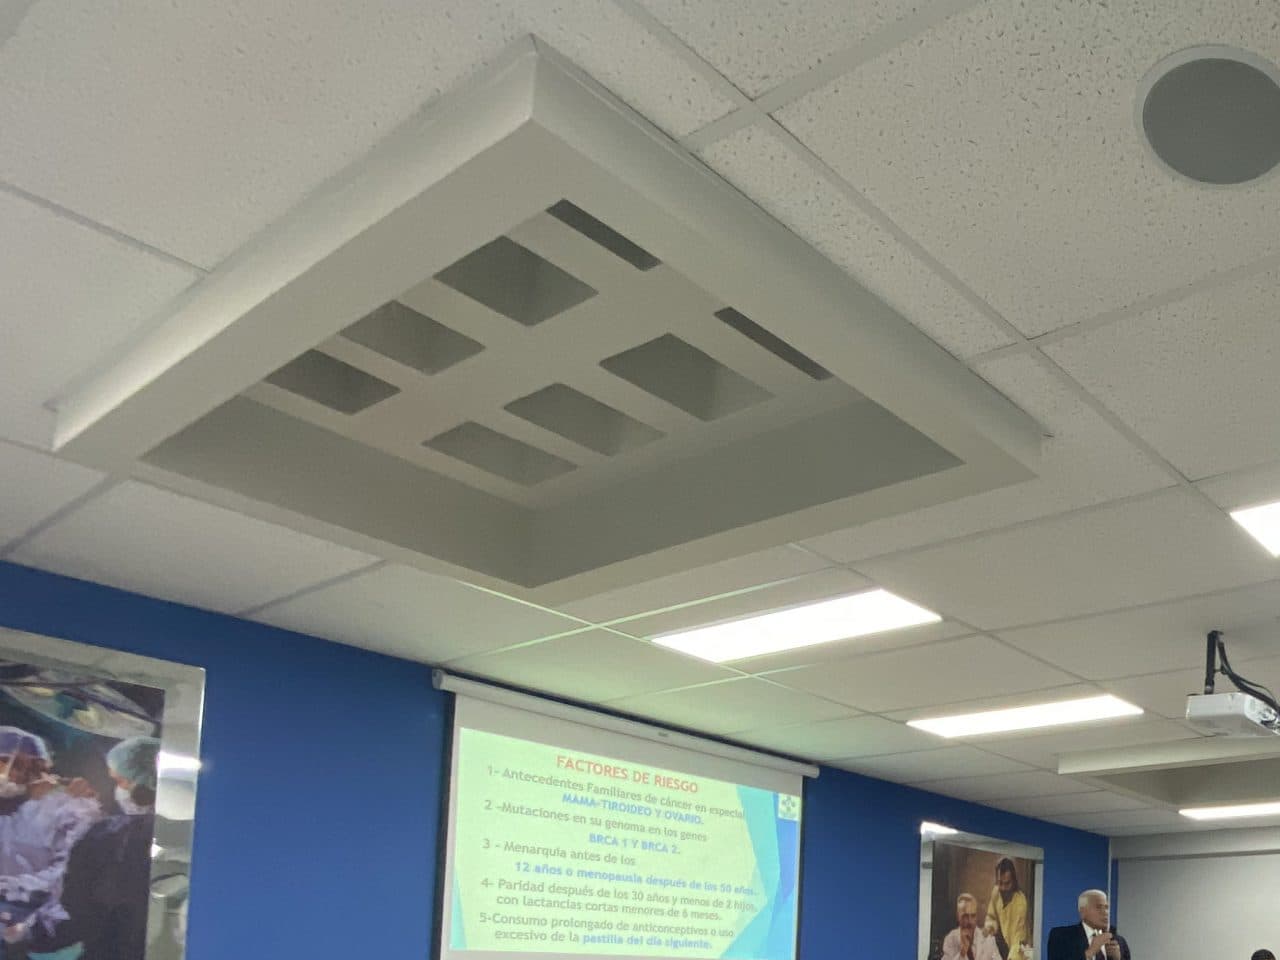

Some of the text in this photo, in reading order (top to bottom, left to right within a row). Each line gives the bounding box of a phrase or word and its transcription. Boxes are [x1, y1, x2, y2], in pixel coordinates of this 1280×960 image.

[557, 755, 698, 793] FACTORES DE RIESGO
[502, 768, 584, 791] Antecedentes
[587, 782, 642, 801] Familiares
[645, 794, 657, 803] de
[660, 796, 692, 810] cáncer
[695, 805, 707, 813] en
[710, 807, 745, 819] especial
[484, 799, 492, 810] 2
[573, 815, 586, 824] en
[590, 818, 602, 826] su
[605, 820, 646, 833] genoma
[648, 826, 660, 834] en
[664, 828, 678, 837] los
[680, 831, 707, 842] genes
[655, 809, 661, 817] Y
[482, 838, 490, 849] 3
[570, 850, 601, 861] antes
[604, 851, 617, 863] de
[621, 855, 636, 865] los
[589, 833, 619, 846] BRCA
[622, 838, 628, 847] 1
[630, 839, 639, 848] Y
[641, 841, 668, 853] BRCA
[515, 861, 530, 872] 12
[535, 864, 562, 876] años
[566, 868, 573, 876] o
[577, 870, 642, 885] menopausia
[646, 875, 686, 888] después
[689, 881, 701, 889] de
[704, 882, 717, 891] los
[720, 883, 731, 893] 50
[496, 895, 519, 905] con
[523, 895, 582, 910] lactancias
[585, 901, 618, 913] cortas
[622, 905, 665, 916] menores
[667, 908, 680, 917] de
[682, 908, 688, 918] 6
[498, 878, 544, 893] Paridad
[548, 882, 593, 897] después
[597, 887, 610, 898] de
[614, 889, 628, 899] los
[632, 890, 644, 900] 30
[646, 893, 669, 904] años
[671, 896, 678, 906] y
[680, 897, 710, 907] menos
[712, 899, 724, 908] de
[726, 900, 733, 909] 2
[494, 930, 547, 941] excesivo
[551, 931, 565, 942] de
[569, 932, 580, 943] la
[583, 933, 623, 945] pastilla
[627, 935, 643, 945] del
[551, 917, 613, 931] prolongado
[616, 920, 630, 931] de
[633, 921, 708, 936] anticonceptivos
[710, 928, 716, 936] o
